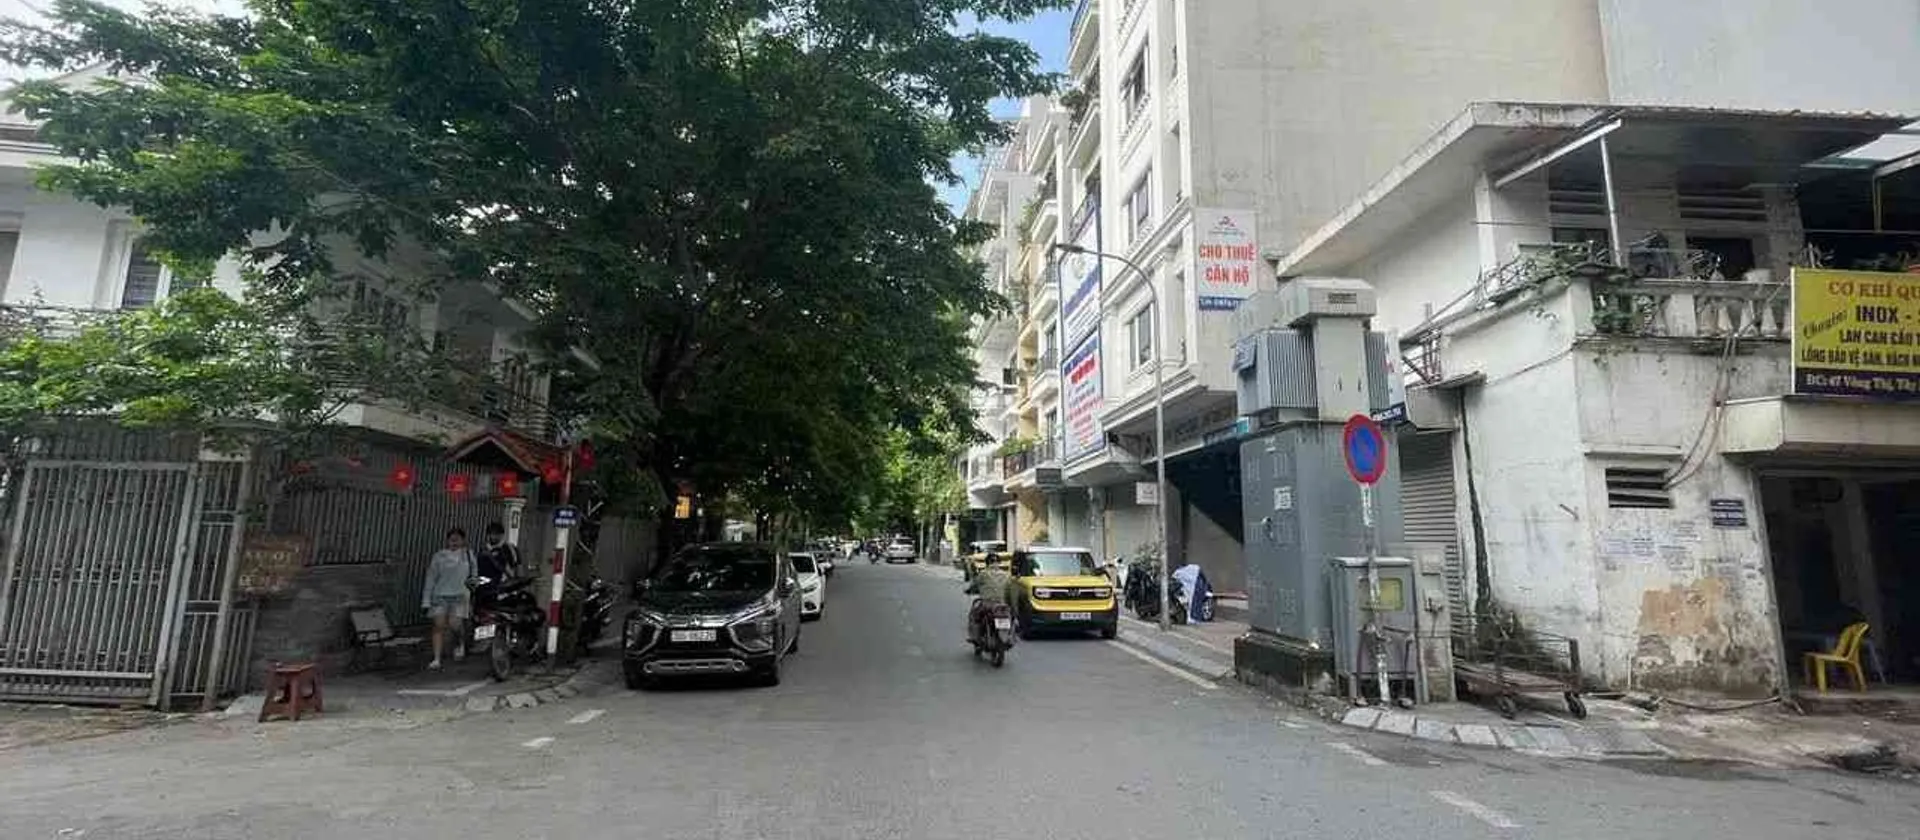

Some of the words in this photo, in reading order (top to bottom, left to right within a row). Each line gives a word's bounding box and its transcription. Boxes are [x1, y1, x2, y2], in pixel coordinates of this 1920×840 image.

[1226, 242, 1256, 261] THUÊ
[1856, 305, 1898, 323] INOX
[1839, 329, 1862, 343] LAN
